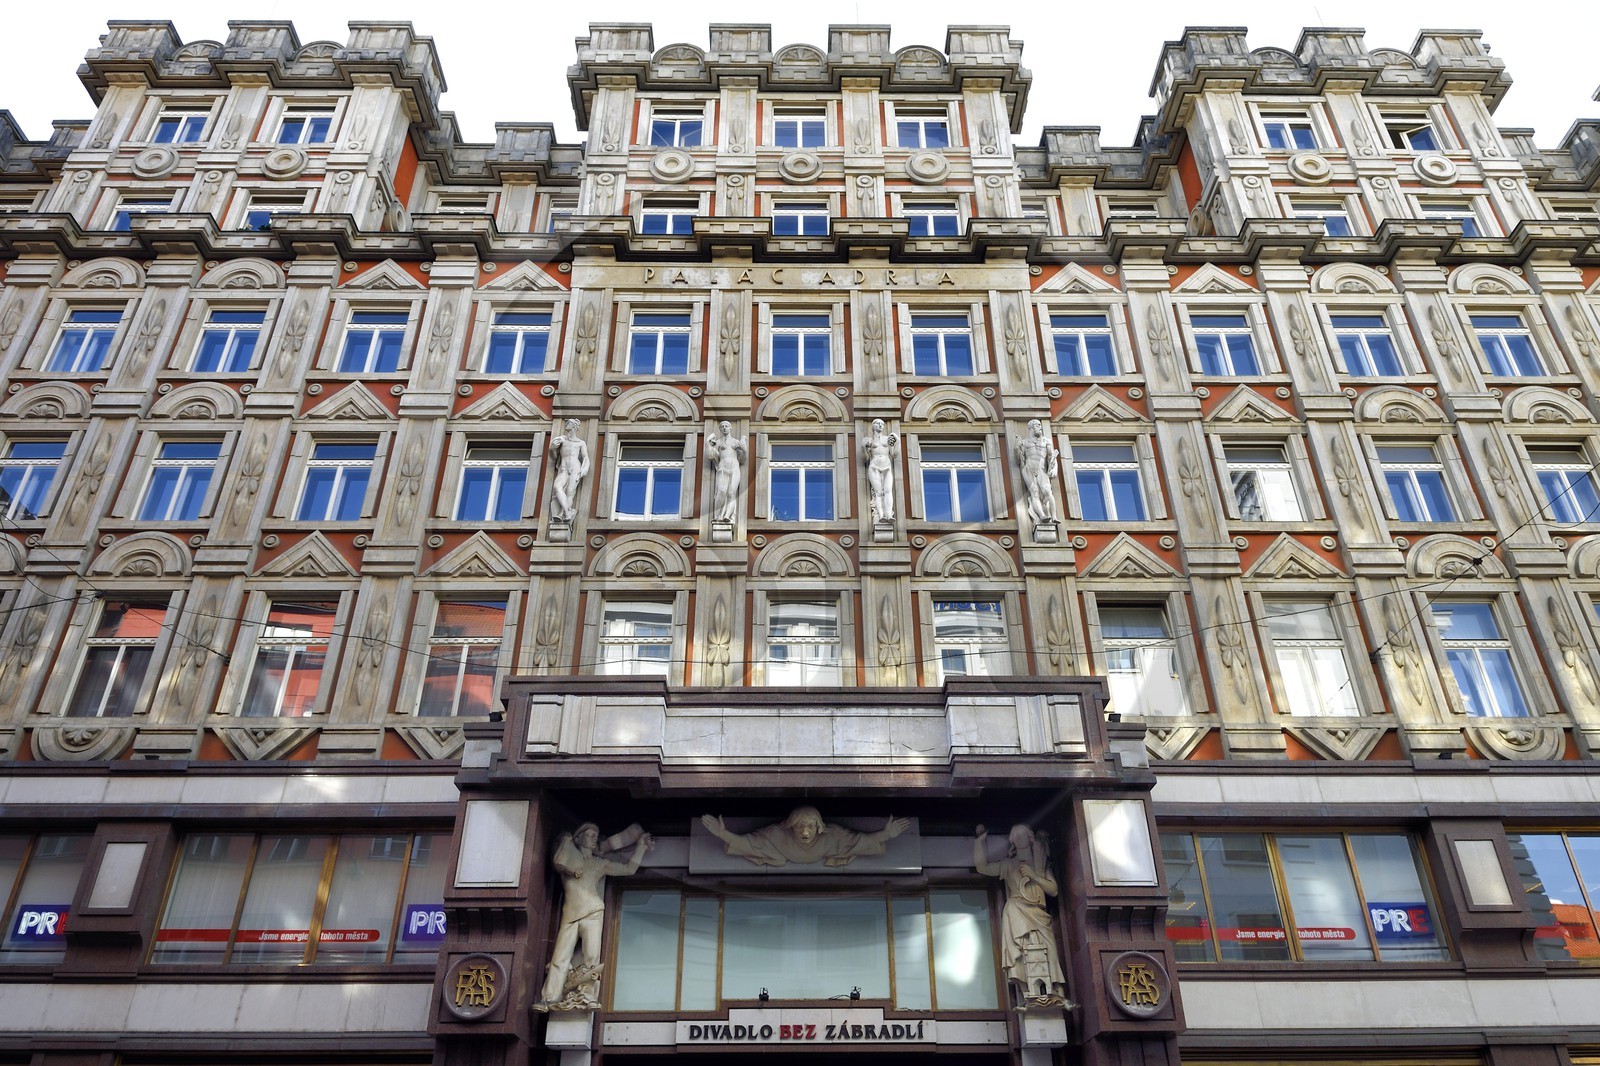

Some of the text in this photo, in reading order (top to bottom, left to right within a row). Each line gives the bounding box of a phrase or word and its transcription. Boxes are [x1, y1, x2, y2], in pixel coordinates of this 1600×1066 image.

[819, 269, 955, 285] ADRIA
[1371, 909, 1429, 932] PRE
[258, 931, 369, 942] Jsme energie tohoto města
[1236, 929, 1345, 939] Jsme energie tohoto města
[689, 1020, 924, 1040] DIVADLO BEZ ZÁBRADLÍ
